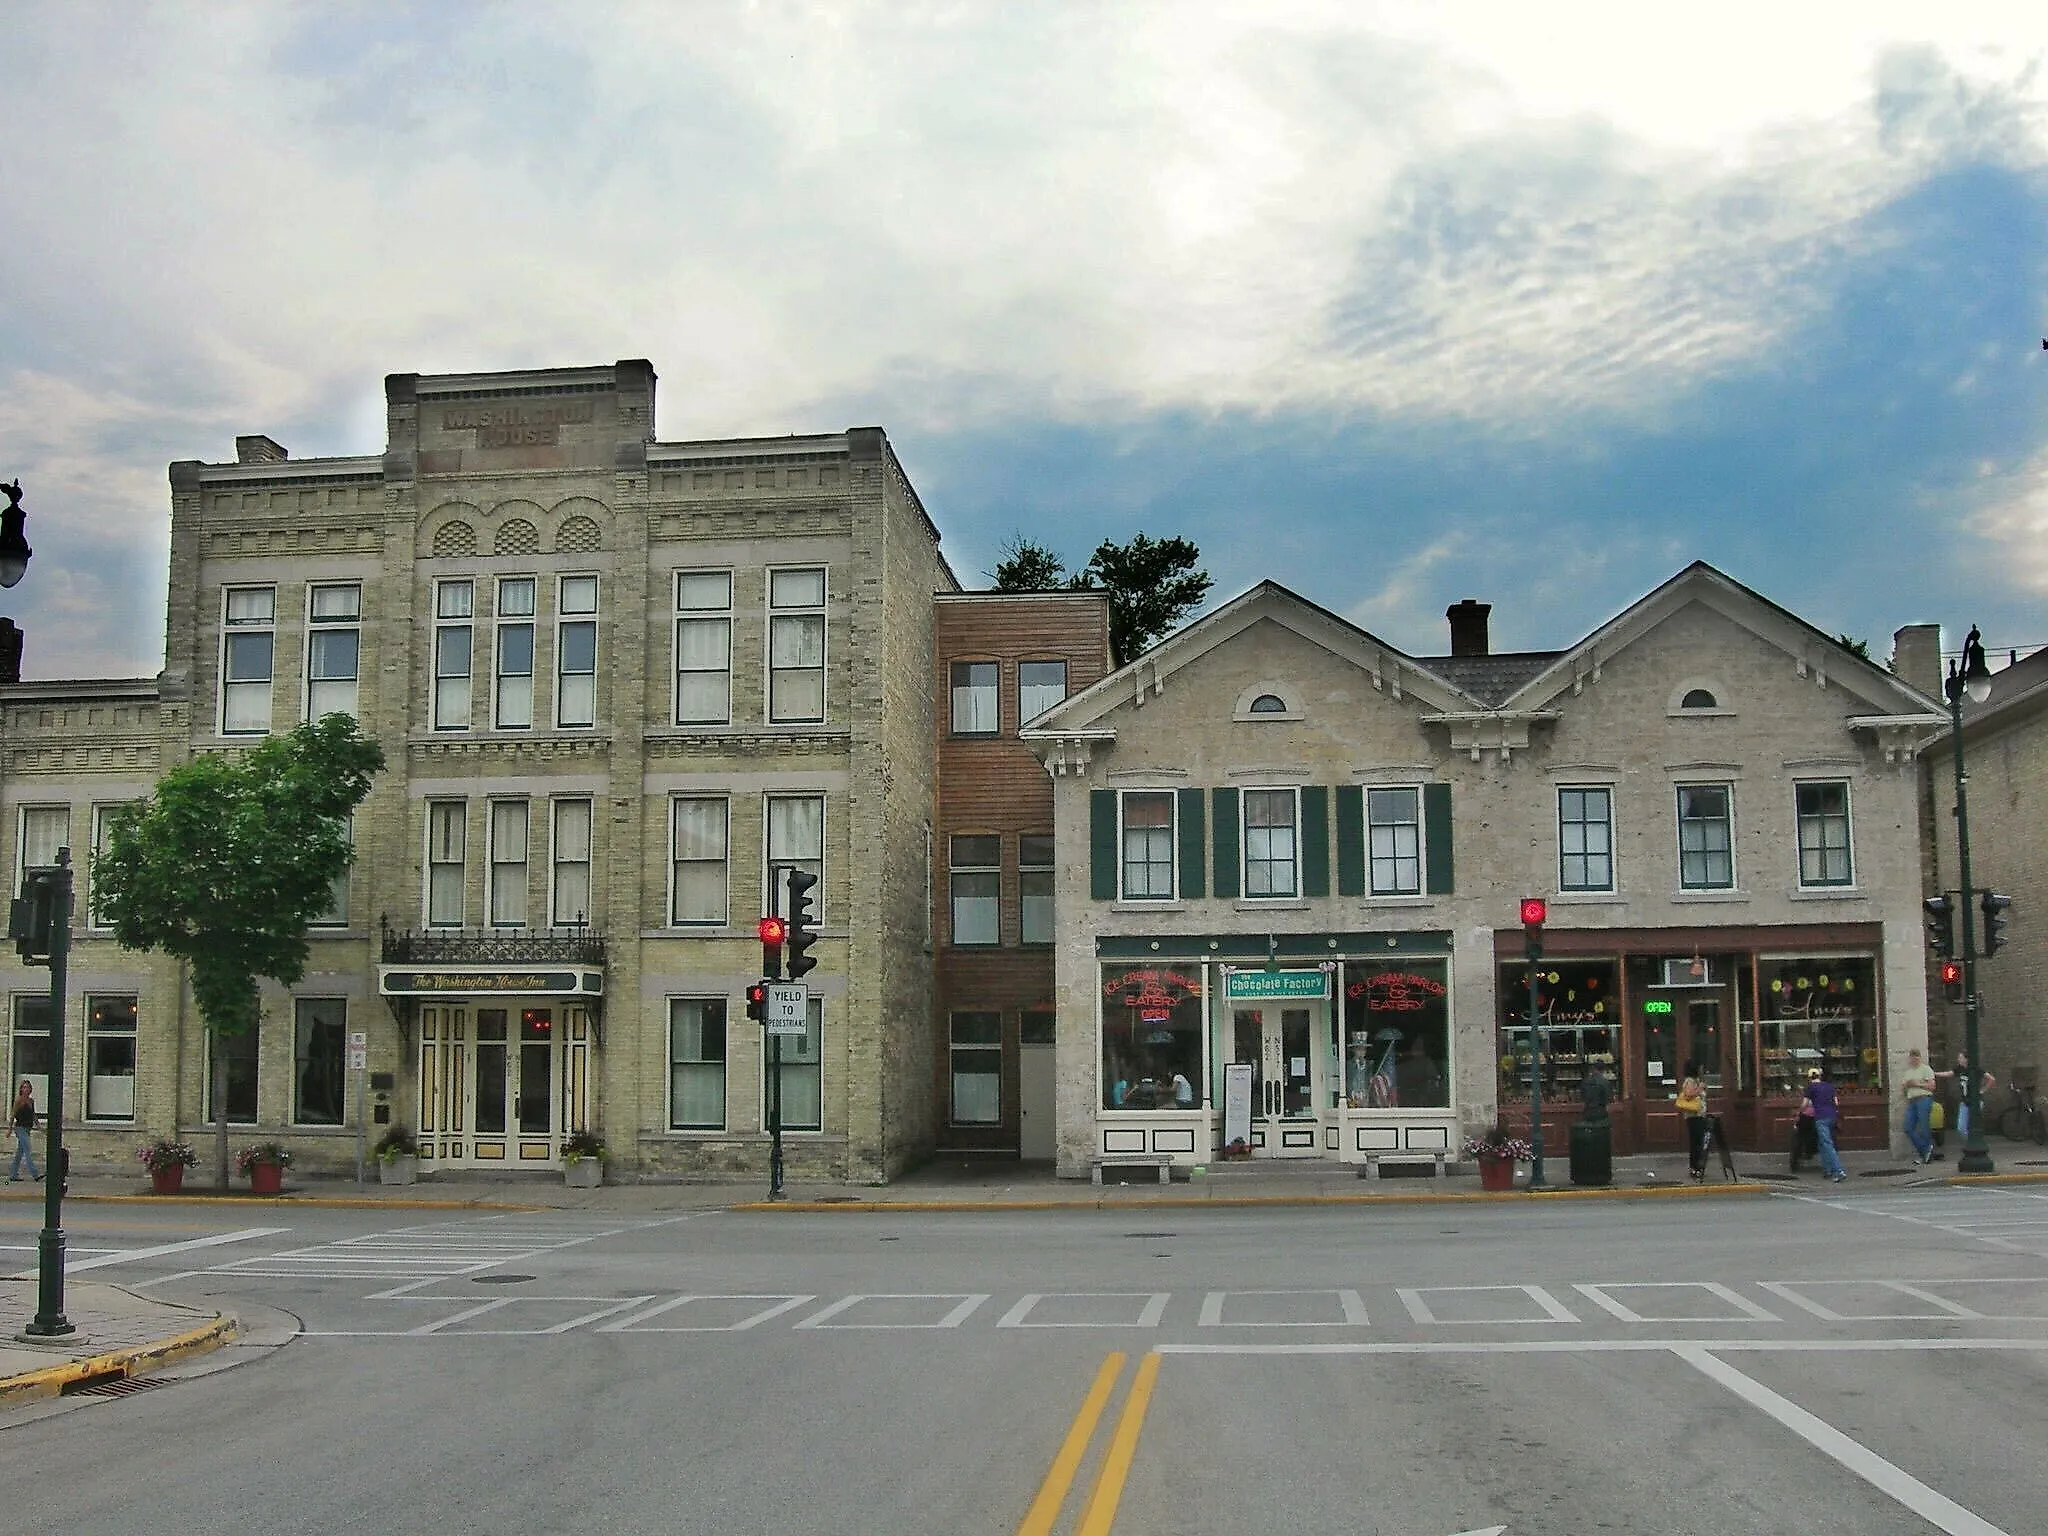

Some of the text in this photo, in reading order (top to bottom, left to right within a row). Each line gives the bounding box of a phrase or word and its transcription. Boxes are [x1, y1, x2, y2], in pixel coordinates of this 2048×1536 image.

[415, 975, 430, 987] The
[433, 975, 493, 990] Washington
[526, 975, 546, 987] Inn
[1231, 977, 1322, 991] Chocolate Factory
[774, 992, 801, 1001] YIELD
[1369, 999, 1424, 1010] EATERY
[1646, 1001, 1672, 1013] OPEN
[782, 1006, 793, 1015] TO
[1141, 1009, 1170, 1018] OPEN
[769, 1019, 806, 1027] PEDESTRIANS
